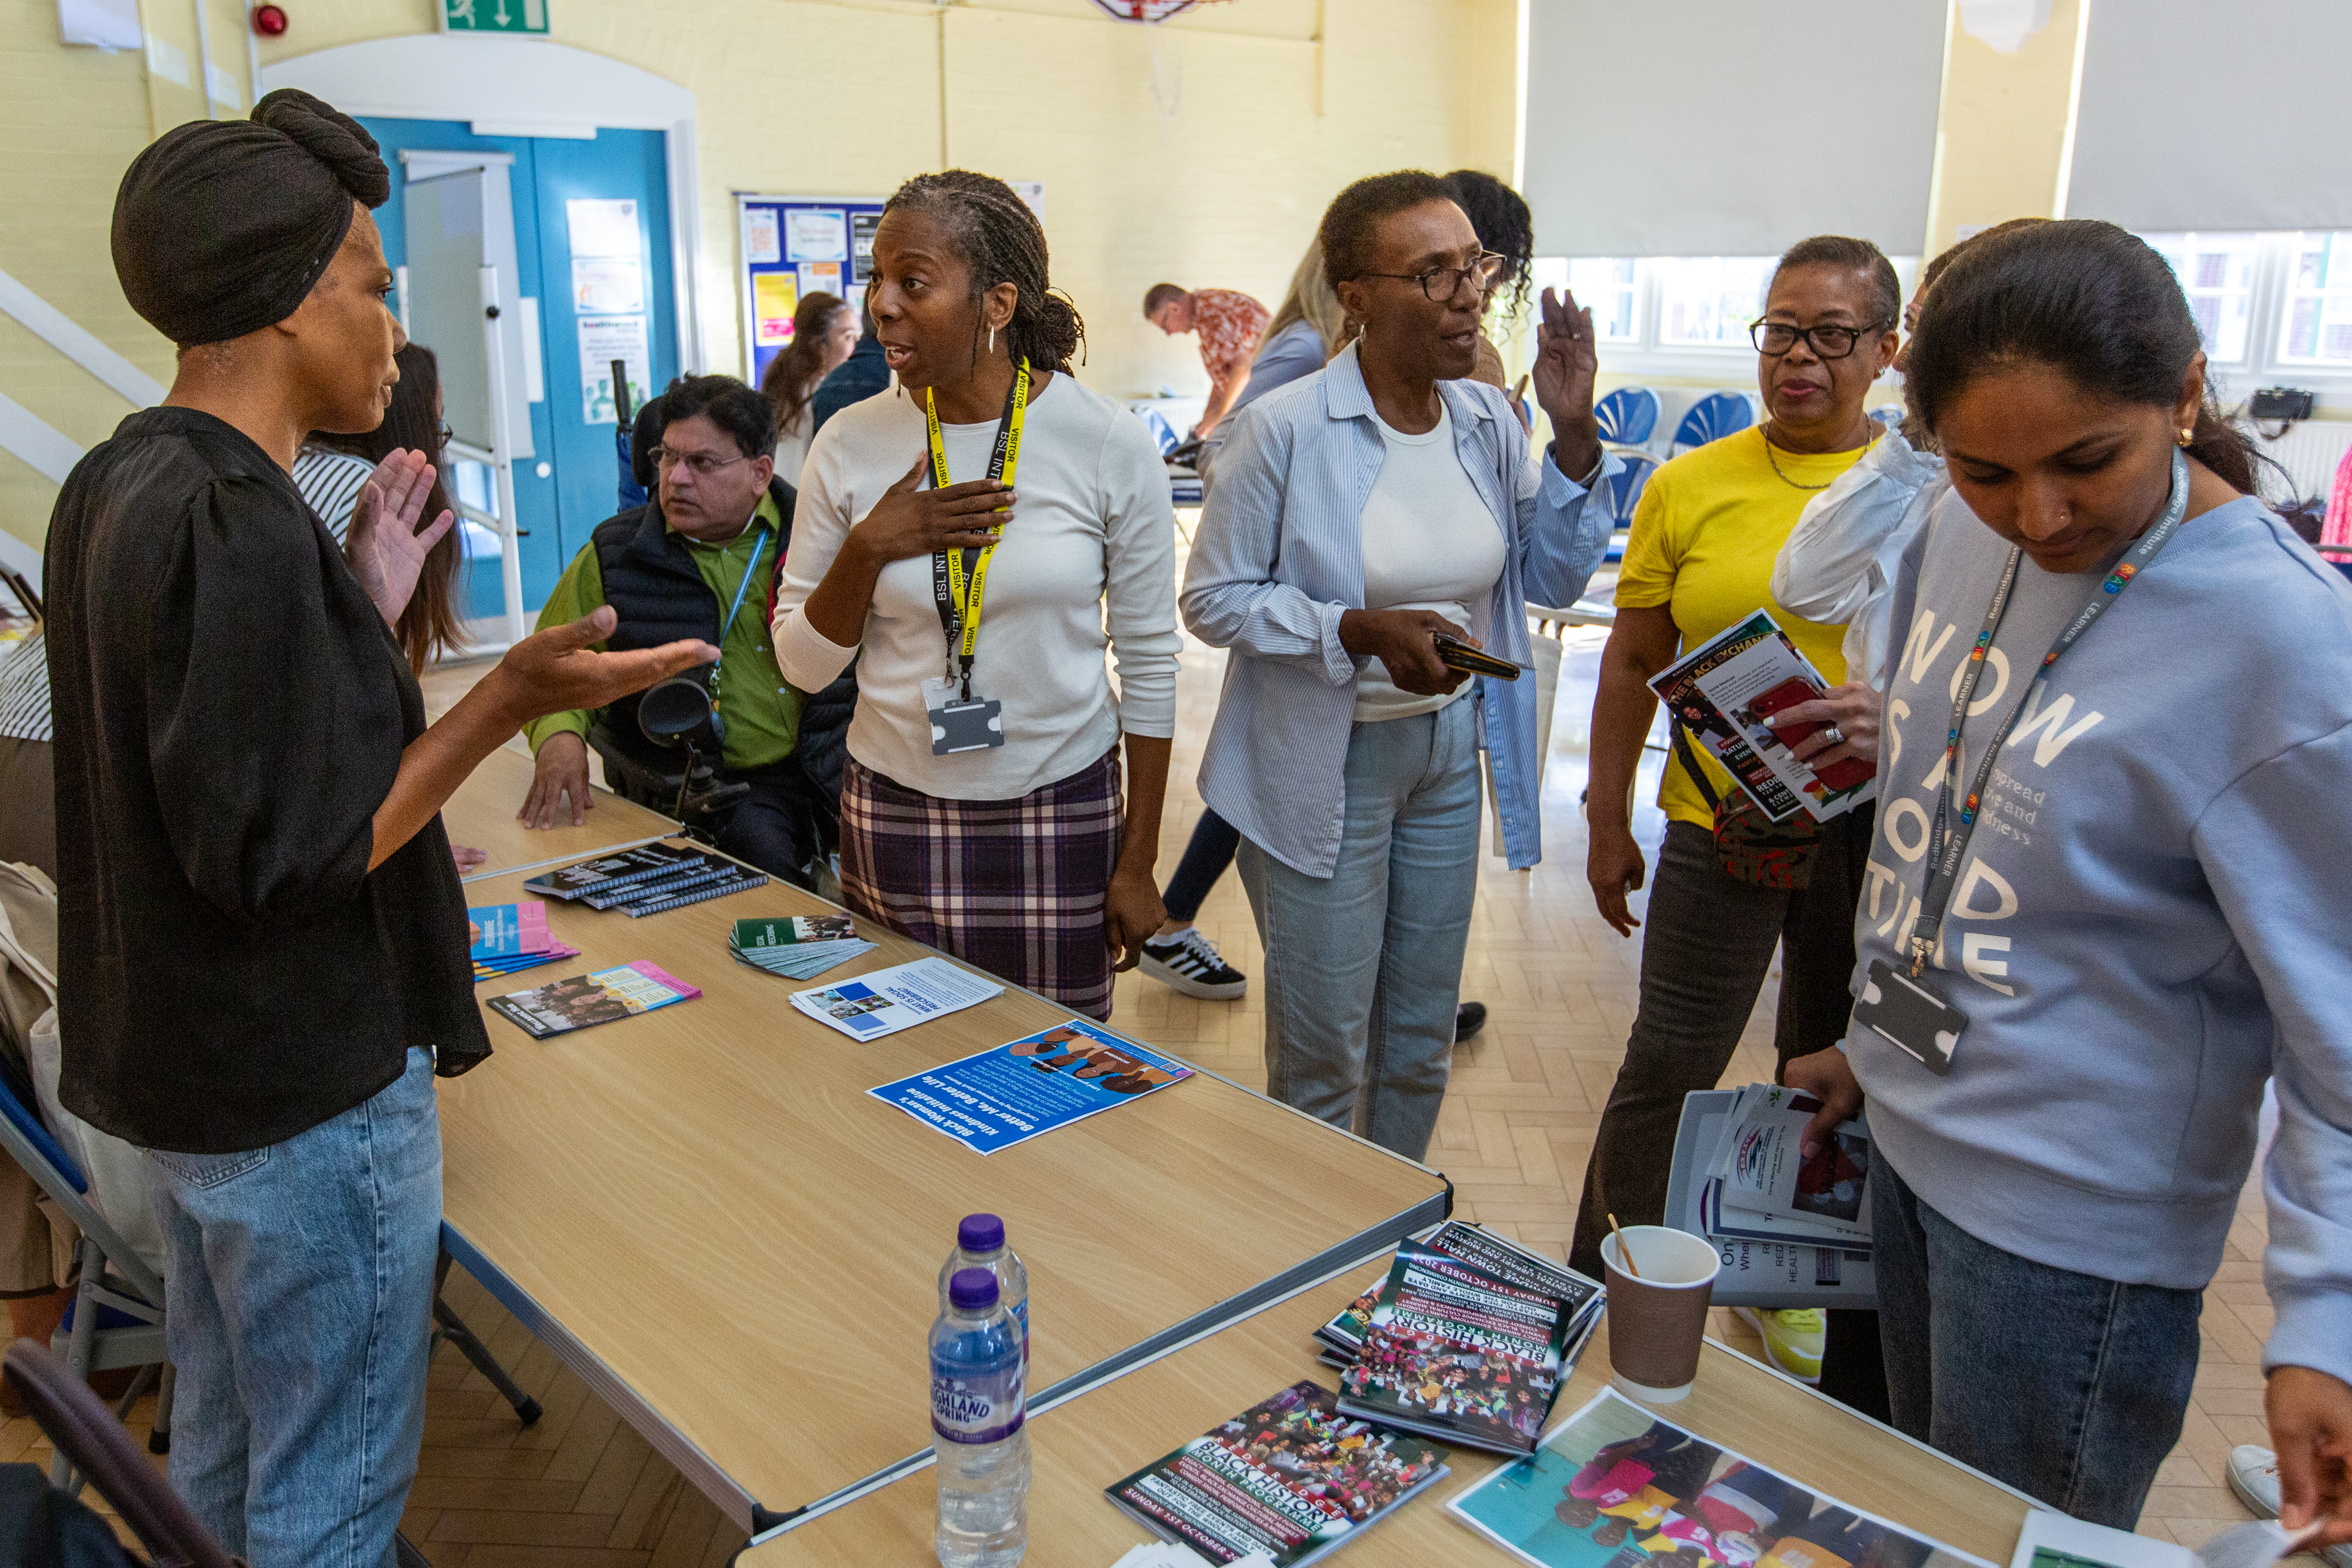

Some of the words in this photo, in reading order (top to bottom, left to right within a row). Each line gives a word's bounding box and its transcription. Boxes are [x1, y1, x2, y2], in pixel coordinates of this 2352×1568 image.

[1016, 375, 1026, 409] VISITOR
[928, 402, 938, 435] VISITOR
[996, 431, 1009, 453] BSL
[1006, 428, 1019, 462] VISITOR
[938, 452, 949, 486] VISITOR
[2138, 516, 2176, 554] Institute
[951, 553, 961, 590] VISITOR
[2103, 562, 2137, 594] RIAE
[937, 577, 947, 601] BSL
[971, 572, 983, 608] VISITOR
[1989, 567, 2011, 619] Redbridge
[2061, 602, 2101, 643] LEARNER
[964, 626, 975, 654] VISITO
[1970, 630, 1989, 662] RIAE
[1672, 668, 1684, 677] BLACK
[1683, 658, 1699, 669] HISTORY
[1715, 639, 1728, 649] BOOKS
[1668, 684, 1688, 706] THE
[1683, 656, 1718, 690] BLACK
[1716, 633, 1772, 666] EXCHAN
[1954, 673, 1974, 717] LEARNER
[1723, 740, 1747, 756] SATUR
[1995, 768, 2045, 807] spread
[1983, 785, 2003, 807] ove
[2004, 801, 2038, 826] and
[1941, 834, 1965, 877] LEARNER
[883, 986, 909, 999] SOCIAL
[896, 986, 942, 1010] PRESCRIBING?
[910, 1001, 933, 1013] WHAT
[1026, 1056, 1052, 1067] campaign
[917, 1075, 947, 1088] Life
[901, 1087, 955, 1113] Initiative
[937, 1085, 981, 1104] Better
[972, 1089, 1002, 1103] empower
[895, 1096, 949, 1123] Woman's
[971, 1101, 1002, 1115] Me,
[1002, 1103, 1041, 1121] Campaigning
[939, 1119, 976, 1137] Black
[946, 1109, 1001, 1136] Kindness
[991, 1111, 1036, 1132] Better
[1434, 1240, 1465, 1258] HALL
[1445, 1231, 1480, 1251] MUSEUM
[1472, 1252, 1501, 1268] ILFORD
[1480, 1248, 1499, 1260] AND
[1484, 1246, 1516, 1262] ILFORD
[1407, 1262, 1447, 1280] COMMENCING
[1465, 1254, 1503, 1277] TOWN
[1499, 1257, 1534, 1276] LIBRARY
[1503, 1267, 1516, 1276] RD,
[1519, 1263, 1534, 1272] RD,
[1406, 1276, 1429, 1287] DAYS
[1421, 1276, 1451, 1288] FAMILY
[1439, 1264, 1488, 1287] OCTOBER
[1447, 1277, 1470, 1287] MONTH
[1519, 1275, 1539, 1287] HIGH
[1534, 1274, 1572, 1293] CENTRAL
[1536, 1272, 1583, 1293] CLEMENTS
[1416, 1287, 1441, 1297] MONTH
[1430, 1283, 1447, 1292] AND
[1448, 1289, 1481, 1301] EVENTS
[1452, 1286, 1481, 1297] WHOLE
[1471, 1285, 1495, 1294] HISTORY
[1491, 1283, 1509, 1294] 1ST
[1496, 1291, 1515, 1300] BLACK
[1394, 1301, 1424, 1311] FUNDAYS
[1401, 1298, 1428, 1308] MARKET
[1410, 1296, 1429, 1304] MORE
[1417, 1292, 1464, 1307] SURROUNDING
[1441, 1293, 1468, 1304] HISTORY
[1469, 1301, 1489, 1309] BLACK
[1482, 1298, 1503, 1307] FREE
[1501, 1298, 1517, 1307] FOR
[1513, 1290, 1556, 1307] SUNDAY
[1516, 1297, 1557, 1313] THROUGHOUT
[1425, 1309, 1447, 1317] FAMILY
[1428, 1305, 1460, 1316] CULTURAL
[1435, 1302, 1487, 1318] PERFORMANCES
[1490, 1306, 1526, 1318] CELEBRATE
[1494, 1311, 1517, 1321] ILFORD
[1505, 1304, 1549, 1320] FANTASTIC
[1518, 1303, 1536, 1312] OUT
[1391, 1307, 1484, 1336] PROGRAMME
[1448, 1315, 1491, 1328] EXHIBITIONS,
[1461, 1313, 1496, 1325] EXCHANGE
[1487, 1315, 1509, 1324] SHOW,
[1497, 1322, 1518, 1331] BLACK
[1510, 1321, 1537, 1332] COMEDY
[1387, 1313, 1474, 1344] HISTORY
[1492, 1325, 1521, 1337] AWARDS,
[1519, 1328, 1545, 1338] EVENTS,
[1389, 1323, 1541, 1369] REDBRIDGE
[1491, 1332, 1545, 1352] MONTH
[1522, 1333, 1548, 1344] LEGACY
[1480, 1337, 1545, 1361] BLACK
[931, 1389, 990, 1418] IGHLAND
[937, 1404, 971, 1423] SPRING
[1199, 1439, 1260, 1478] BLACK
[1253, 1474, 1336, 1527] HISTORY
[1213, 1435, 1343, 1517] REDBRIDGE
[1189, 1448, 1239, 1479] MONTH
[1237, 1478, 1322, 1531] PROGRAMME
[1123, 1488, 1165, 1514] SUNDAY
[1162, 1512, 1183, 1525] 1ST
[1180, 1523, 1228, 1553] OCTOBER
